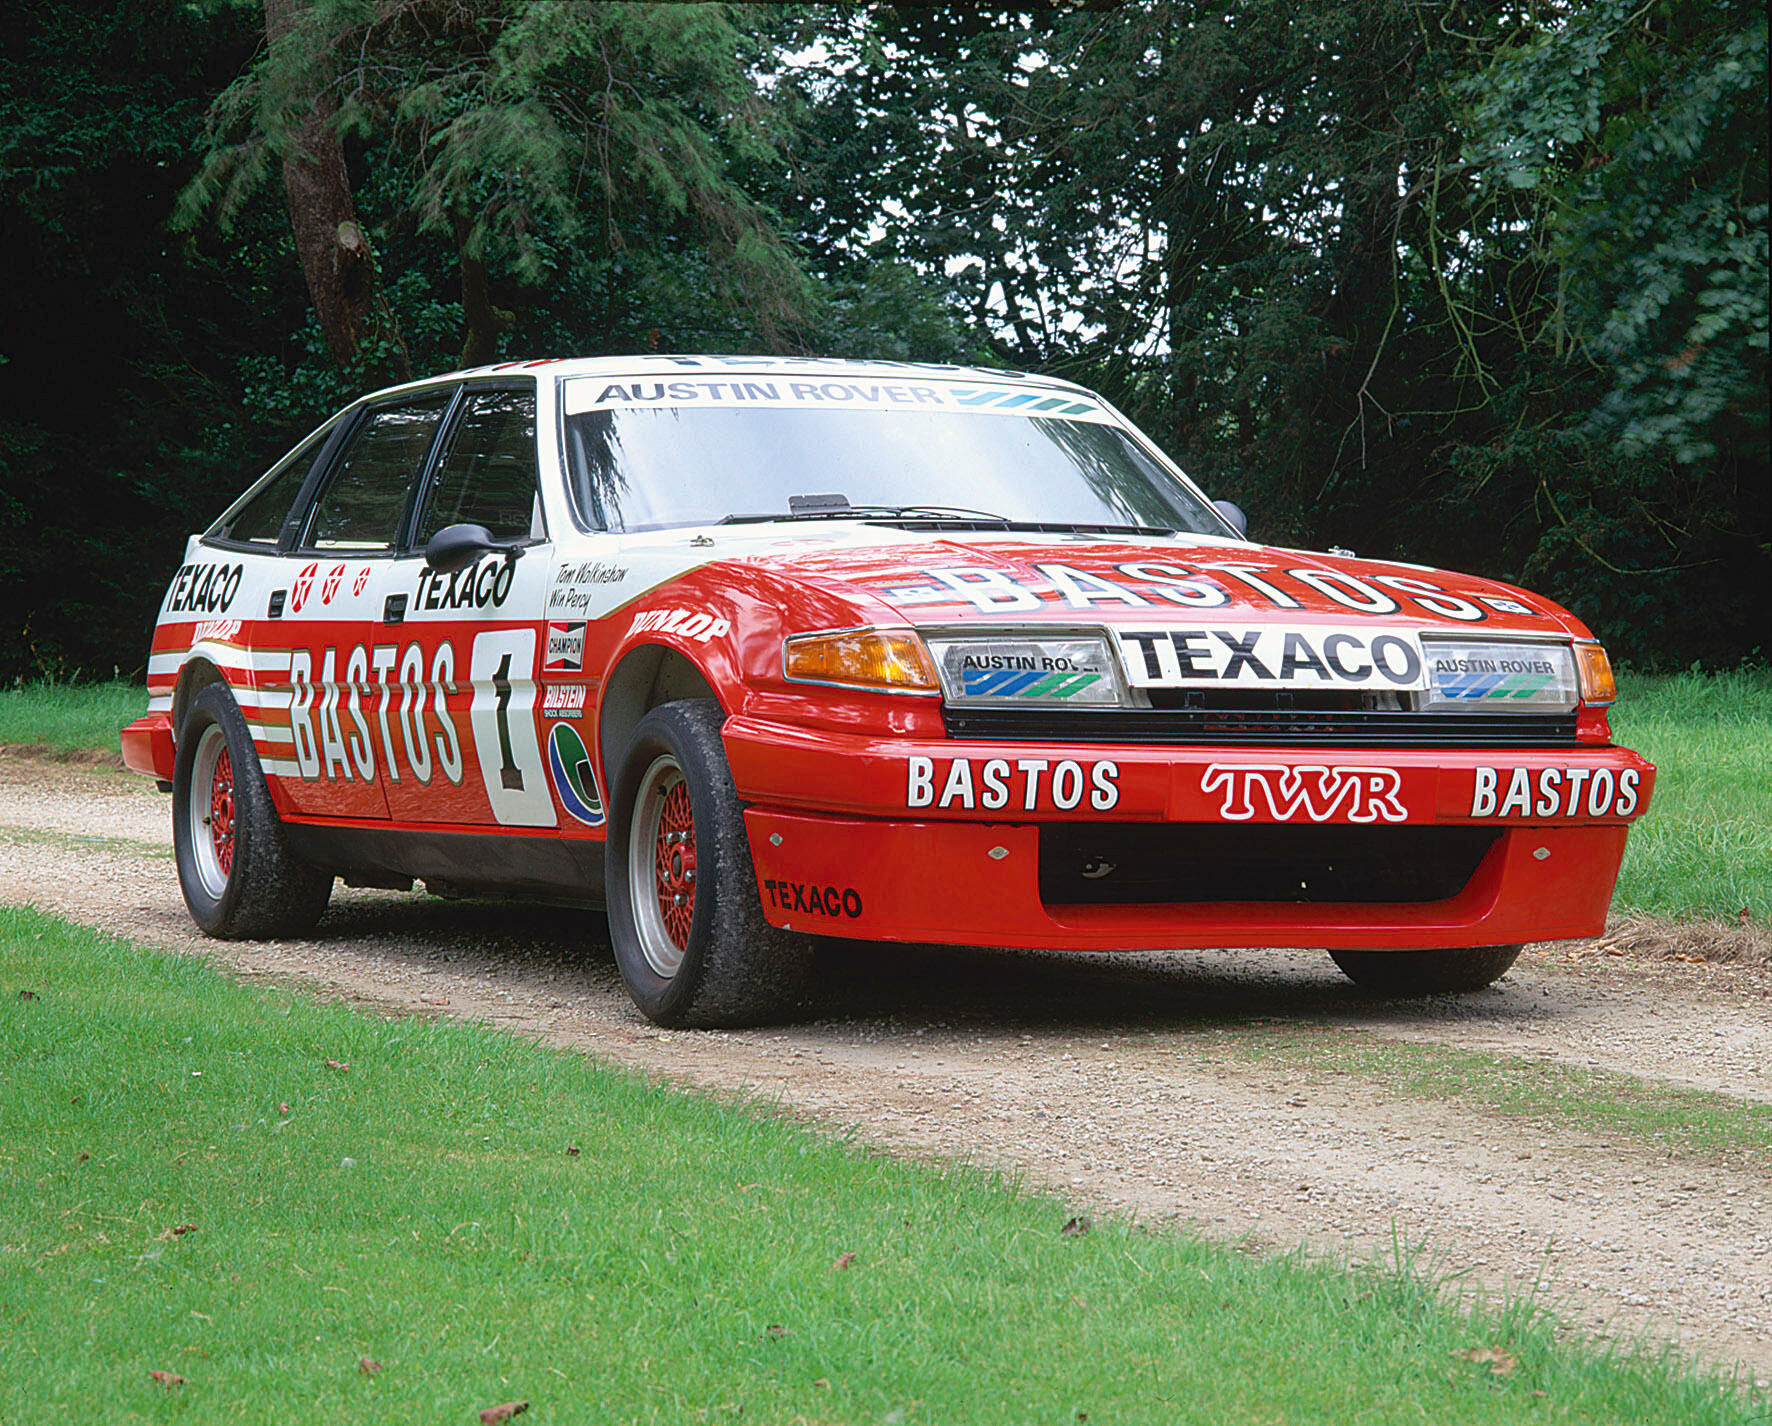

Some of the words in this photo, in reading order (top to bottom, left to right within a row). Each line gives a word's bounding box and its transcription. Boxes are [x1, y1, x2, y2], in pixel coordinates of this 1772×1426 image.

[595, 383, 781, 402] AUSTIN
[789, 382, 945, 404] ROVER
[165, 564, 243, 613] TEXACO
[413, 556, 516, 612] TEXACO
[556, 563, 575, 584] Tom
[575, 561, 629, 584] Walkinshaw
[919, 562, 1489, 622] BASTOS
[549, 588, 564, 608] Win
[565, 588, 591, 616] Percy
[549, 637, 582, 654] CHAMPION
[623, 607, 731, 643] DUNLOP
[963, 655, 1036, 671] AUSTIN
[1120, 630, 1421, 686] TEXACO
[1435, 659, 1497, 674] AUSTIN
[1501, 660, 1555, 675] ROVER
[290, 639, 463, 788] BASTOS
[543, 685, 586, 708] BILSTEIN
[492, 653, 525, 792] 1
[906, 756, 1120, 812] BASTOS
[1200, 763, 1409, 823] TWR
[1470, 766, 1640, 818] BASTOS
[765, 879, 863, 919] TEXACO
